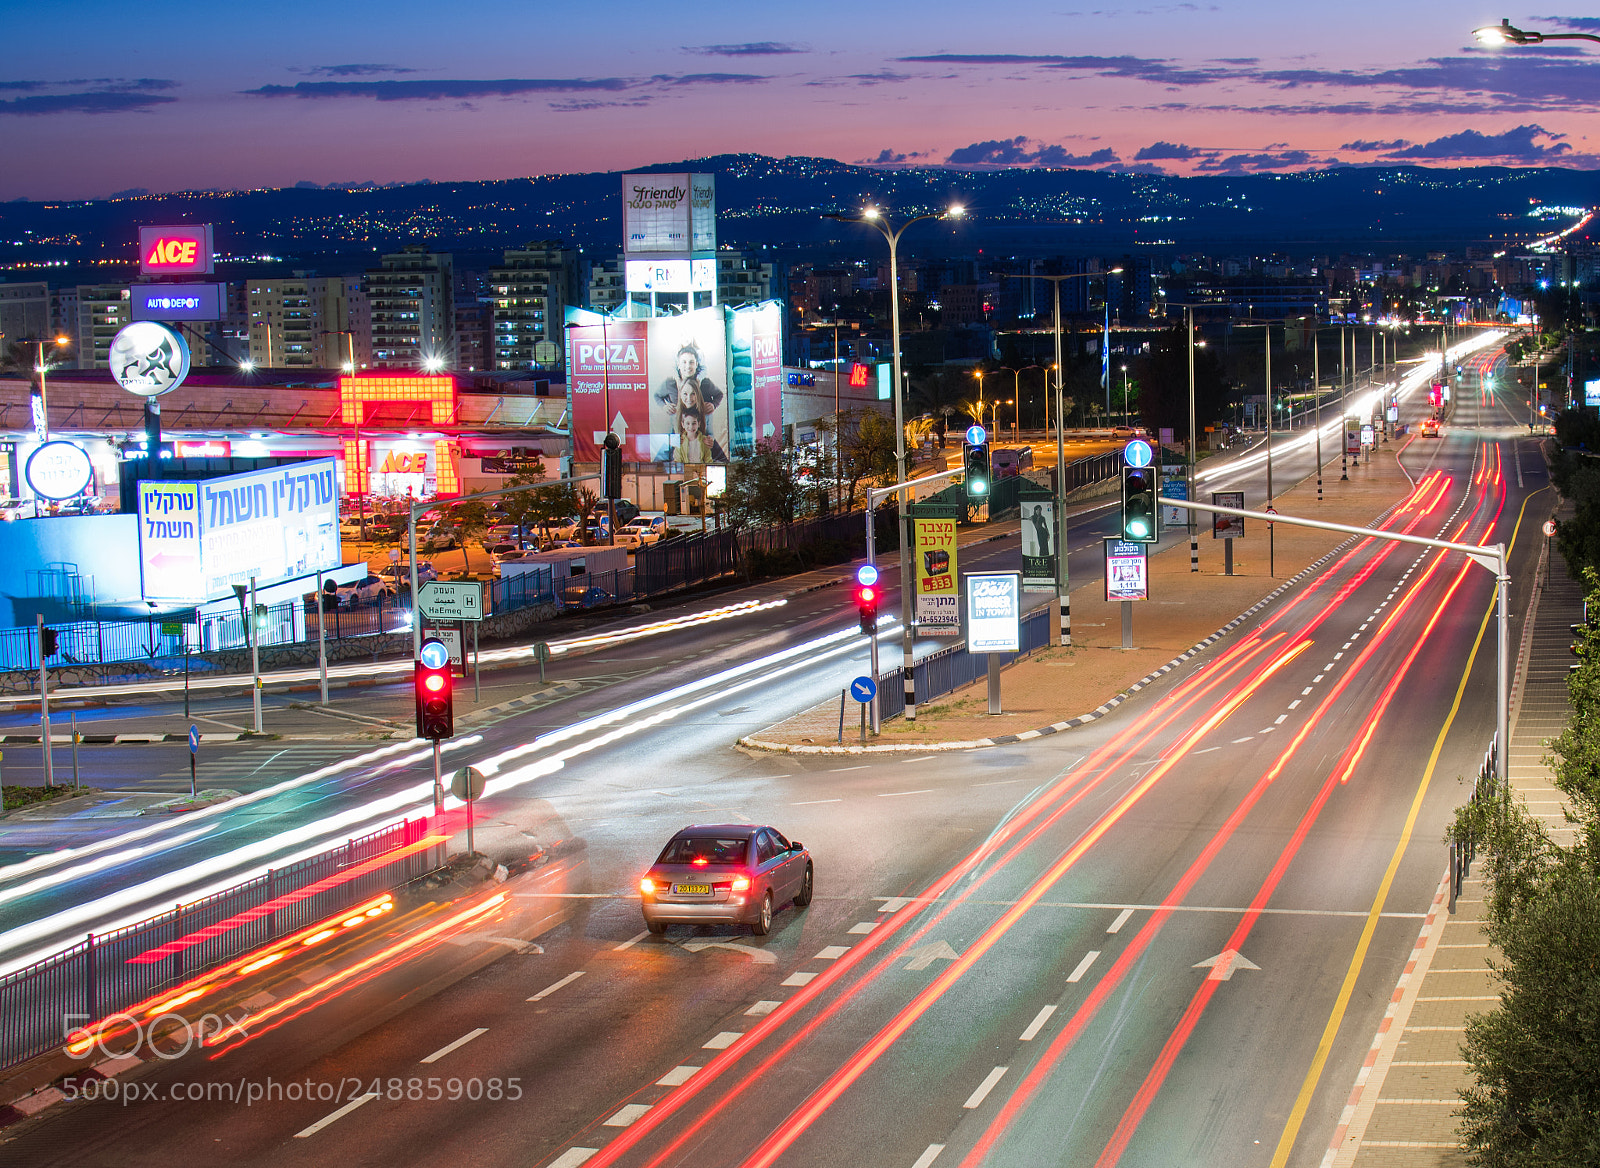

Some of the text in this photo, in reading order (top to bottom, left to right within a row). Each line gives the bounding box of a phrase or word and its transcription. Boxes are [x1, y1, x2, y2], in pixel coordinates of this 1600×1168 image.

[634, 186, 686, 203] friendly
[627, 200, 677, 210] עמק סנטר
[148, 238, 197, 264] ACE
[580, 344, 640, 364] POZA
[755, 337, 778, 358] POZA
[849, 363, 867, 386] ACE
[633, 383, 647, 392] כאן
[379, 449, 427, 473] ACE
[144, 489, 194, 515] טרקלין
[205, 469, 333, 529] טרקלין חשמל
[146, 517, 194, 539] חשמל
[920, 523, 953, 533] מצבר
[920, 533, 953, 546] לרכב
[1028, 558, 1048, 567] T&E
[932, 577, 951, 590] 333
[433, 586, 455, 595] העמק
[936, 597, 956, 607] מתן
[428, 606, 462, 616] HaEmeq
[918, 615, 958, 623] 04-6523946
